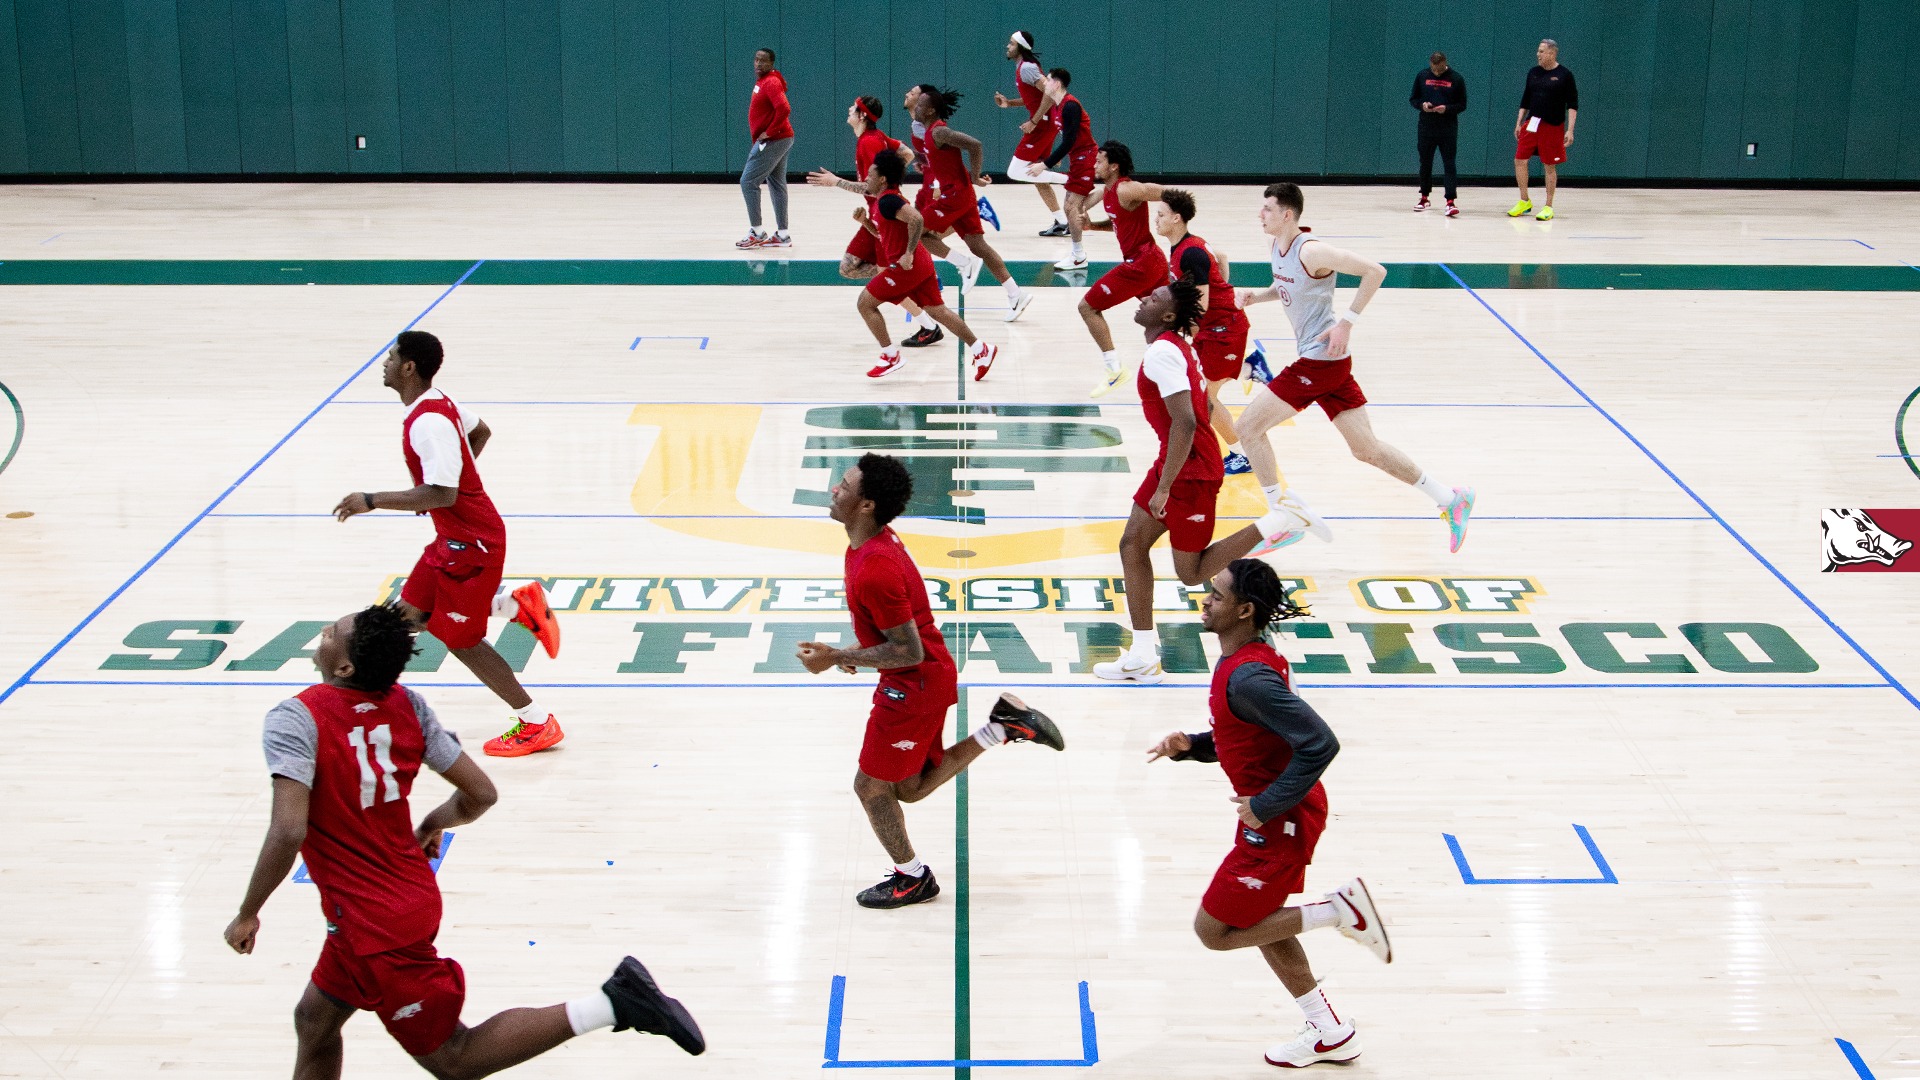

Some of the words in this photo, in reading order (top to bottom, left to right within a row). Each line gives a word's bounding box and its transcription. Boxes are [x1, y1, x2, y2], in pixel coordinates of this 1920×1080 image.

[376, 574, 1316, 614] NIVESIT
[1347, 575, 1547, 614] OF
[347, 724, 400, 810] 11
